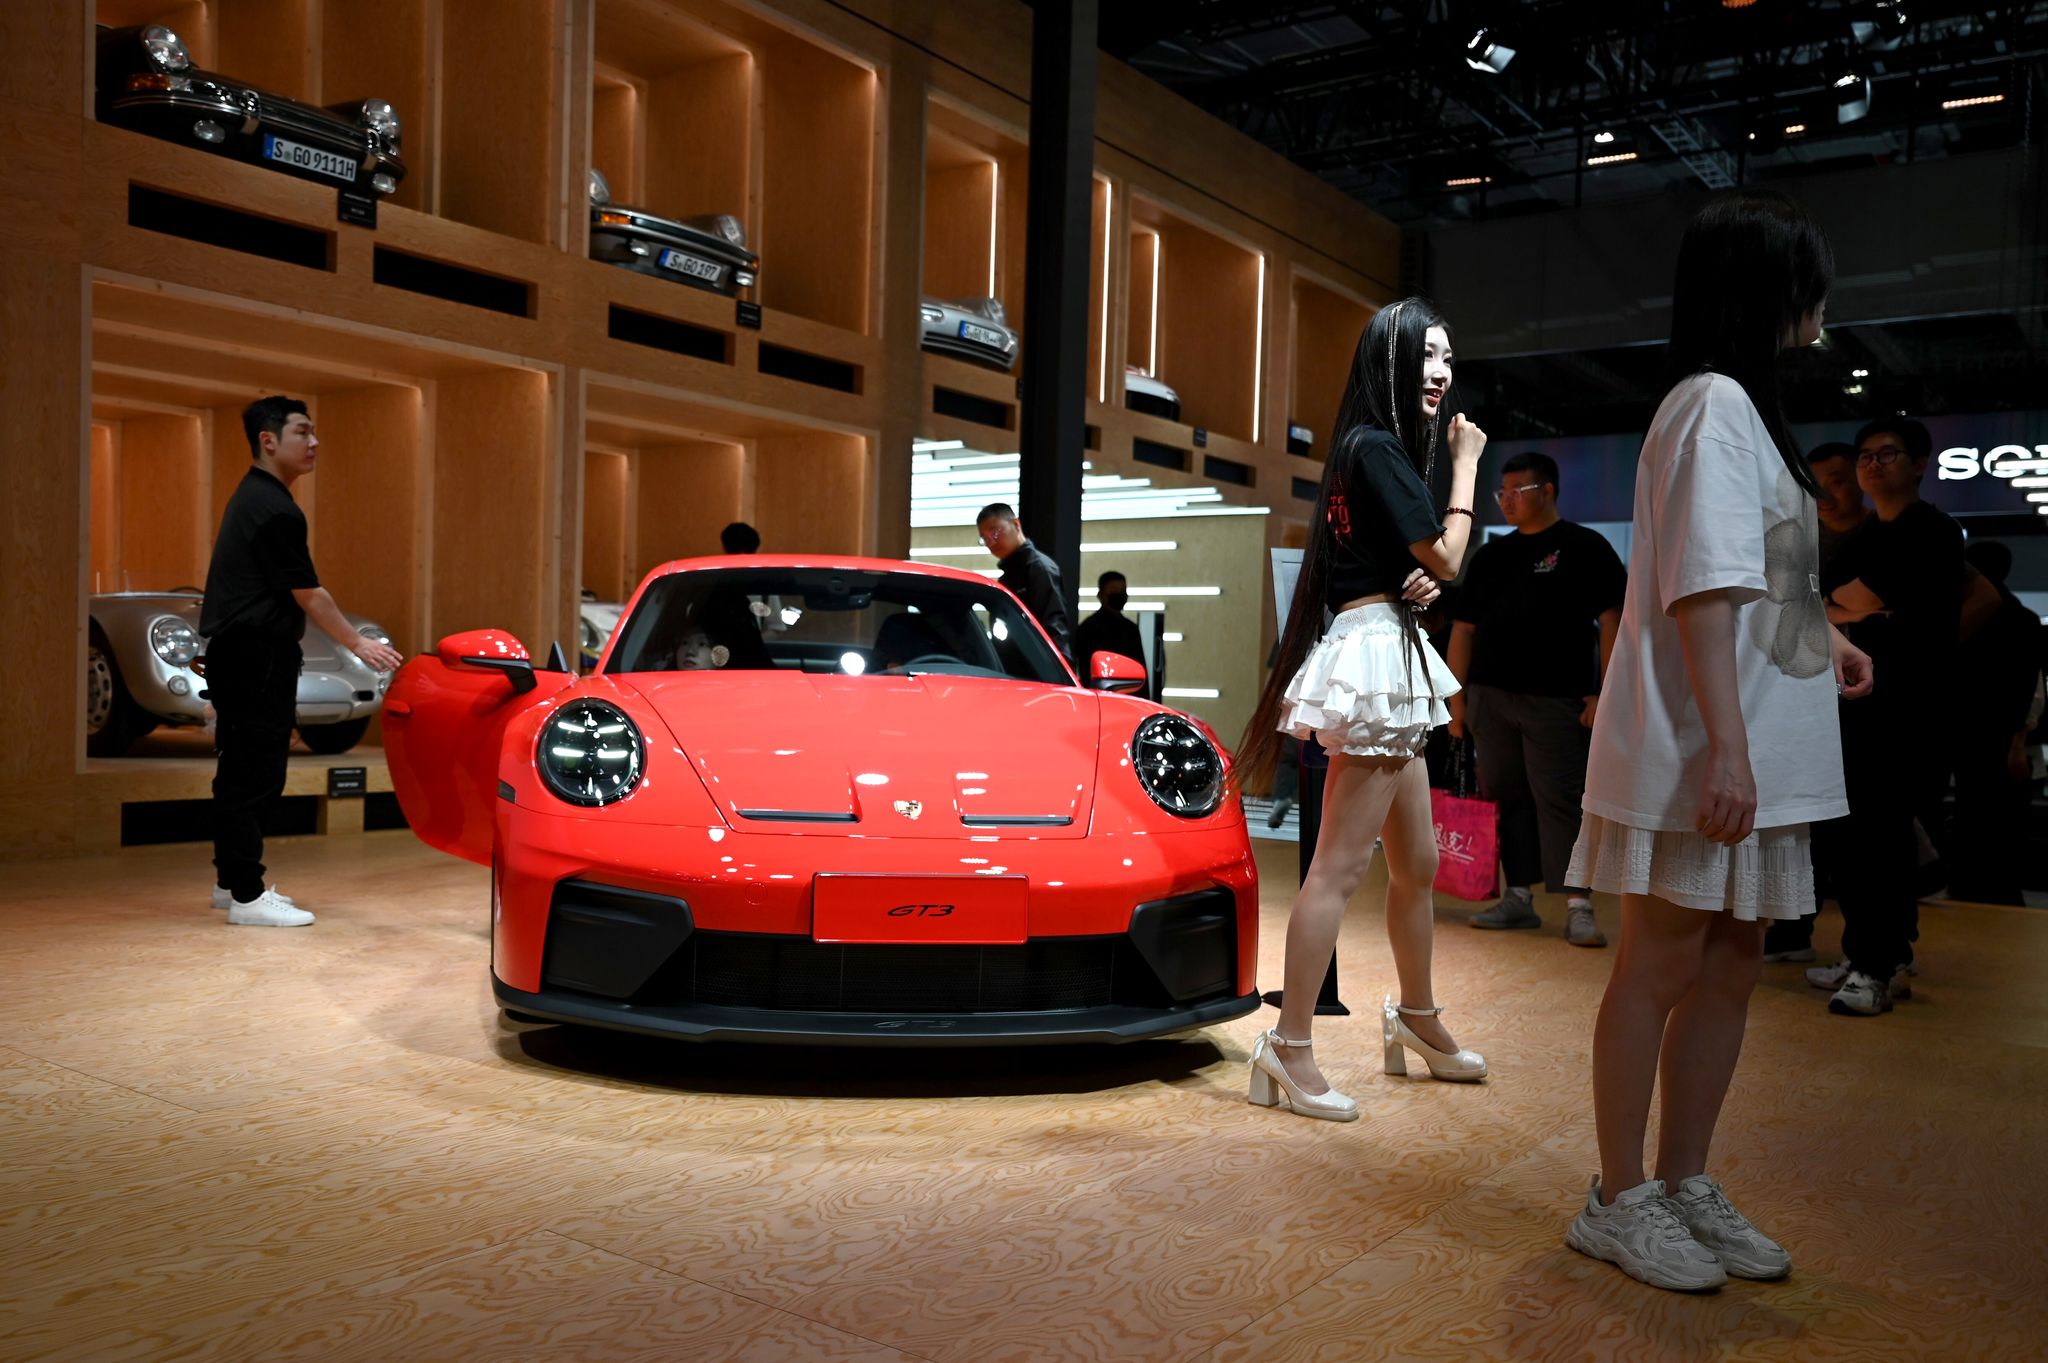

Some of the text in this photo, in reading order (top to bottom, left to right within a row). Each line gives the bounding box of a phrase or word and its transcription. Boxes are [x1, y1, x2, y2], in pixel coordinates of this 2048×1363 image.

[274, 141, 356, 179] S GO 9111H
[670, 254, 680, 268] S
[697, 263, 718, 279] 197
[1938, 444, 2048, 480] SO
[887, 904, 956, 917] GT3
